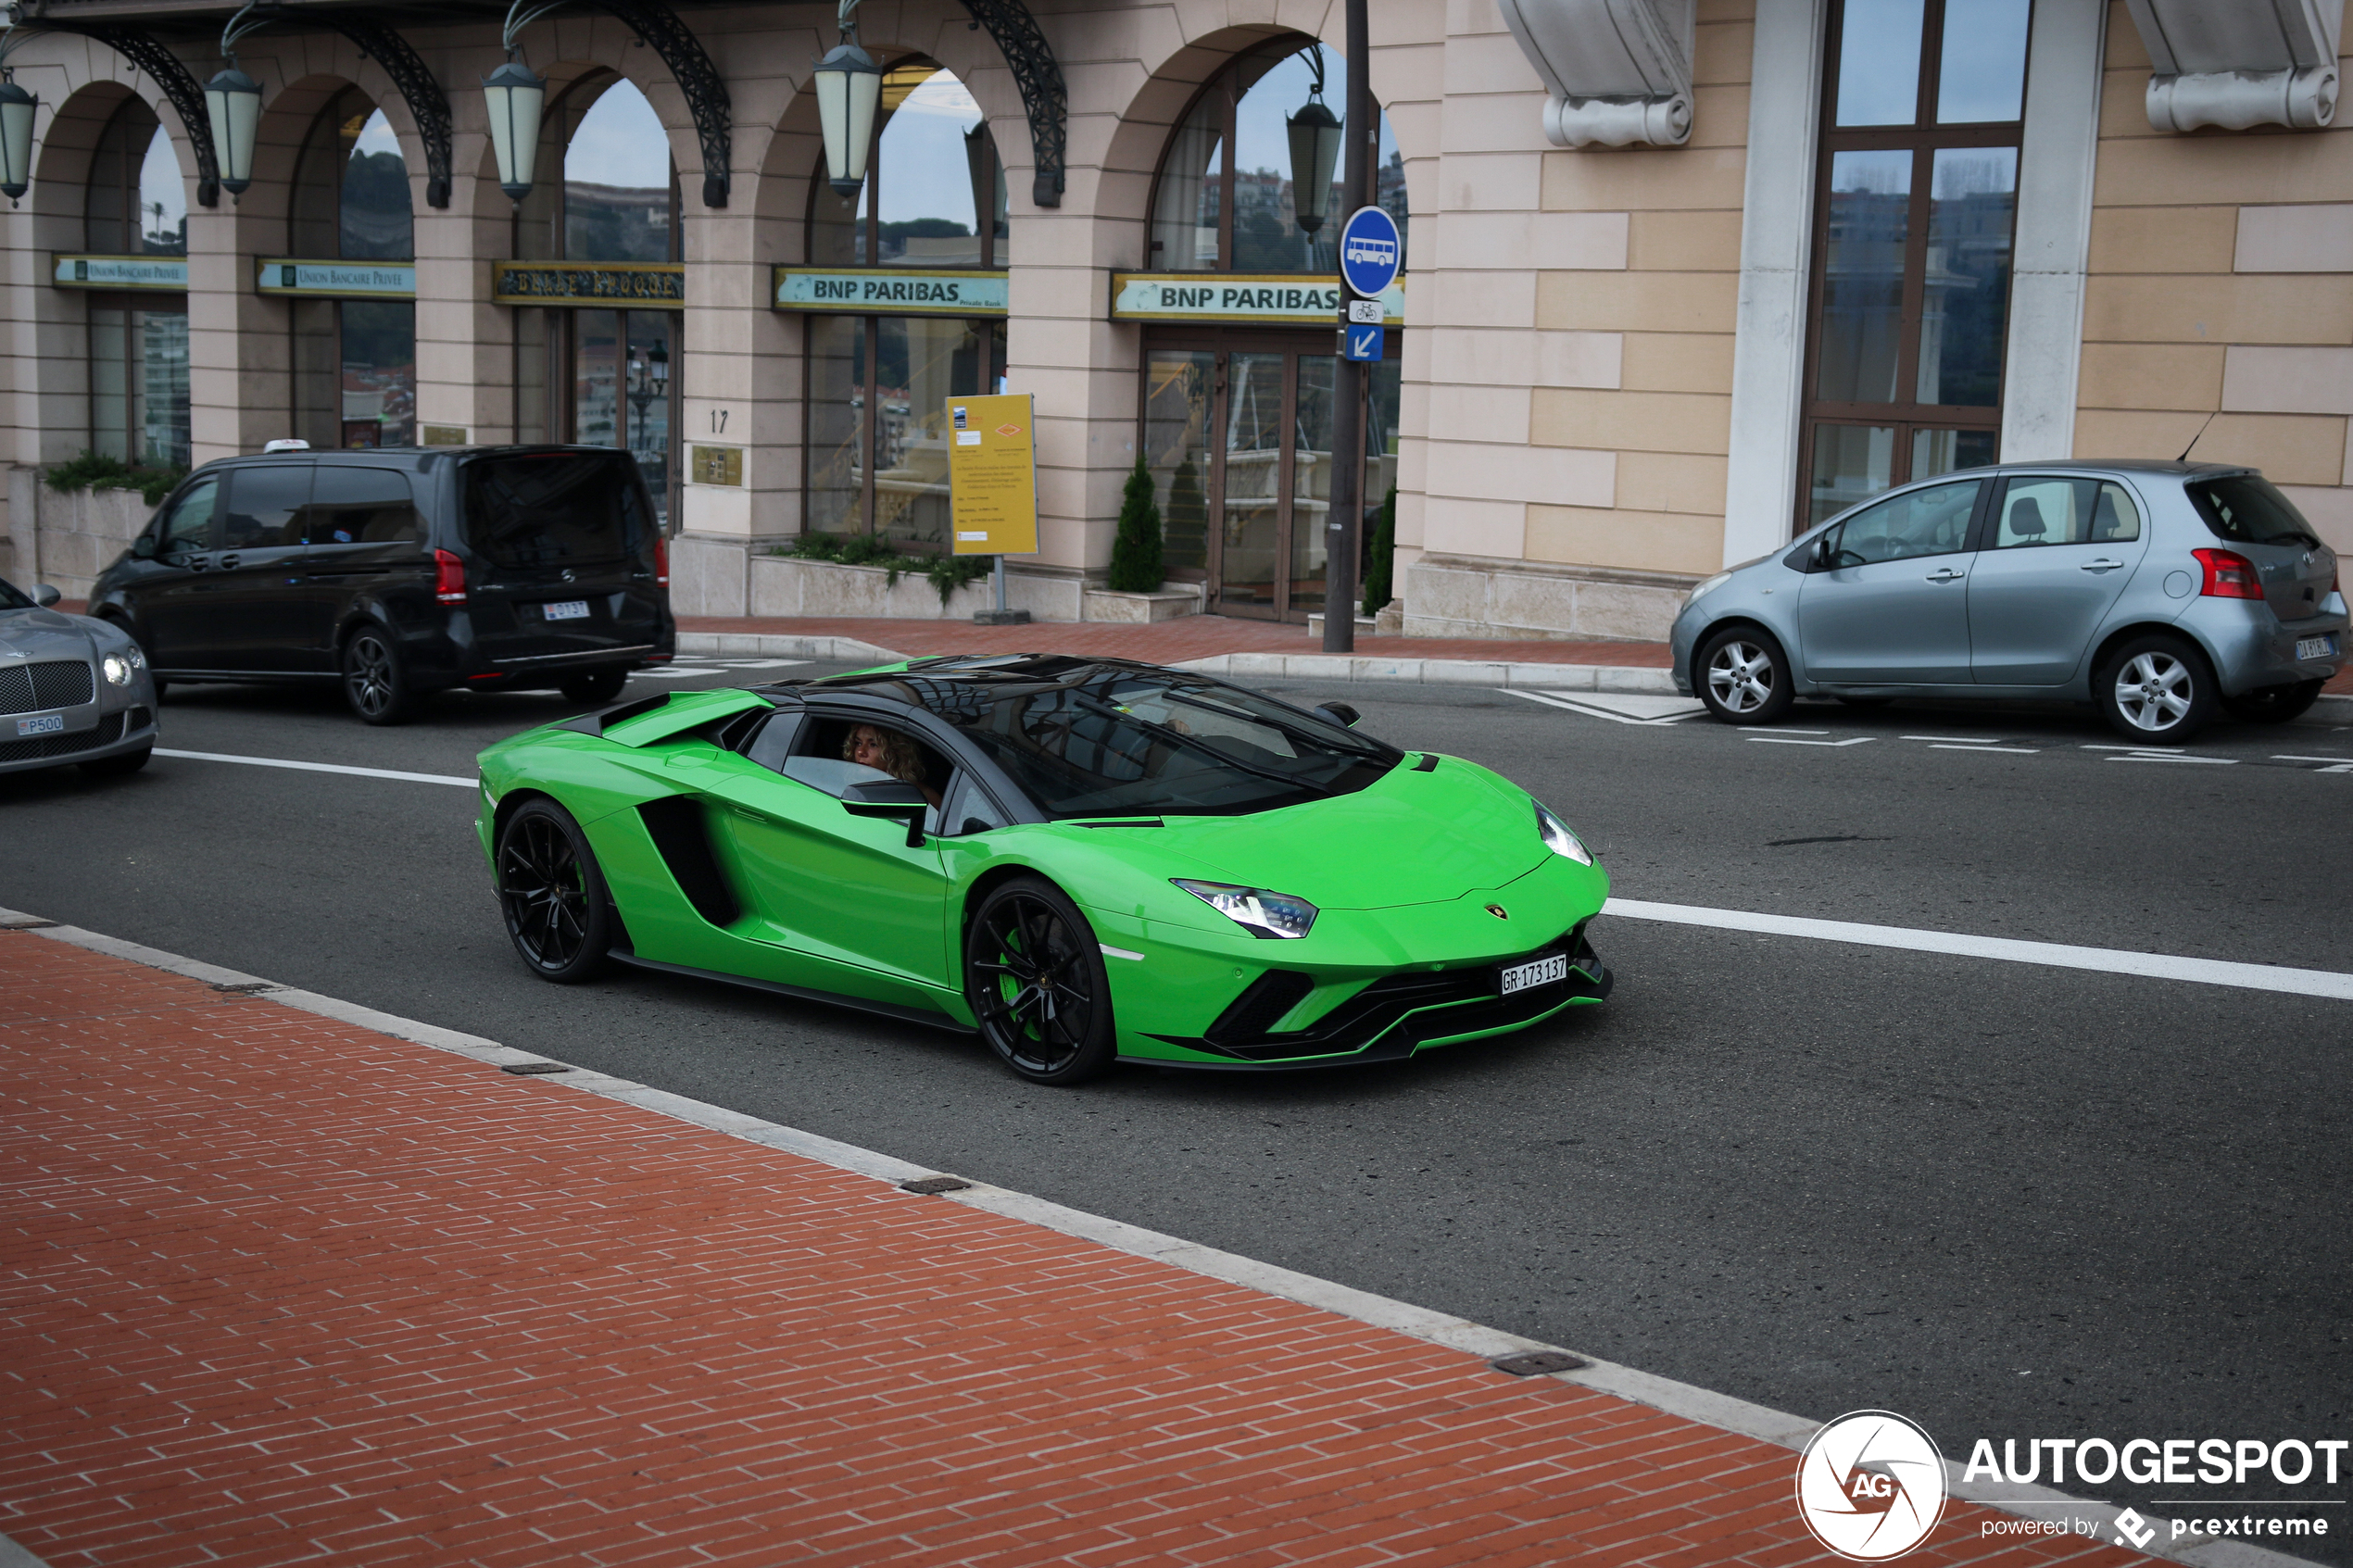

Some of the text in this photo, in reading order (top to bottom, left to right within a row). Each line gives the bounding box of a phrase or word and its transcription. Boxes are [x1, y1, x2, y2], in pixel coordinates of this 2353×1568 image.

[518, 273, 577, 293] BELLE
[814, 280, 959, 302] BNP PARIBAS
[1161, 287, 1340, 309] BNP PARIBAS
[711, 409, 729, 433] 17
[30, 717, 62, 732] P500
[1545, 957, 1566, 981] 137
